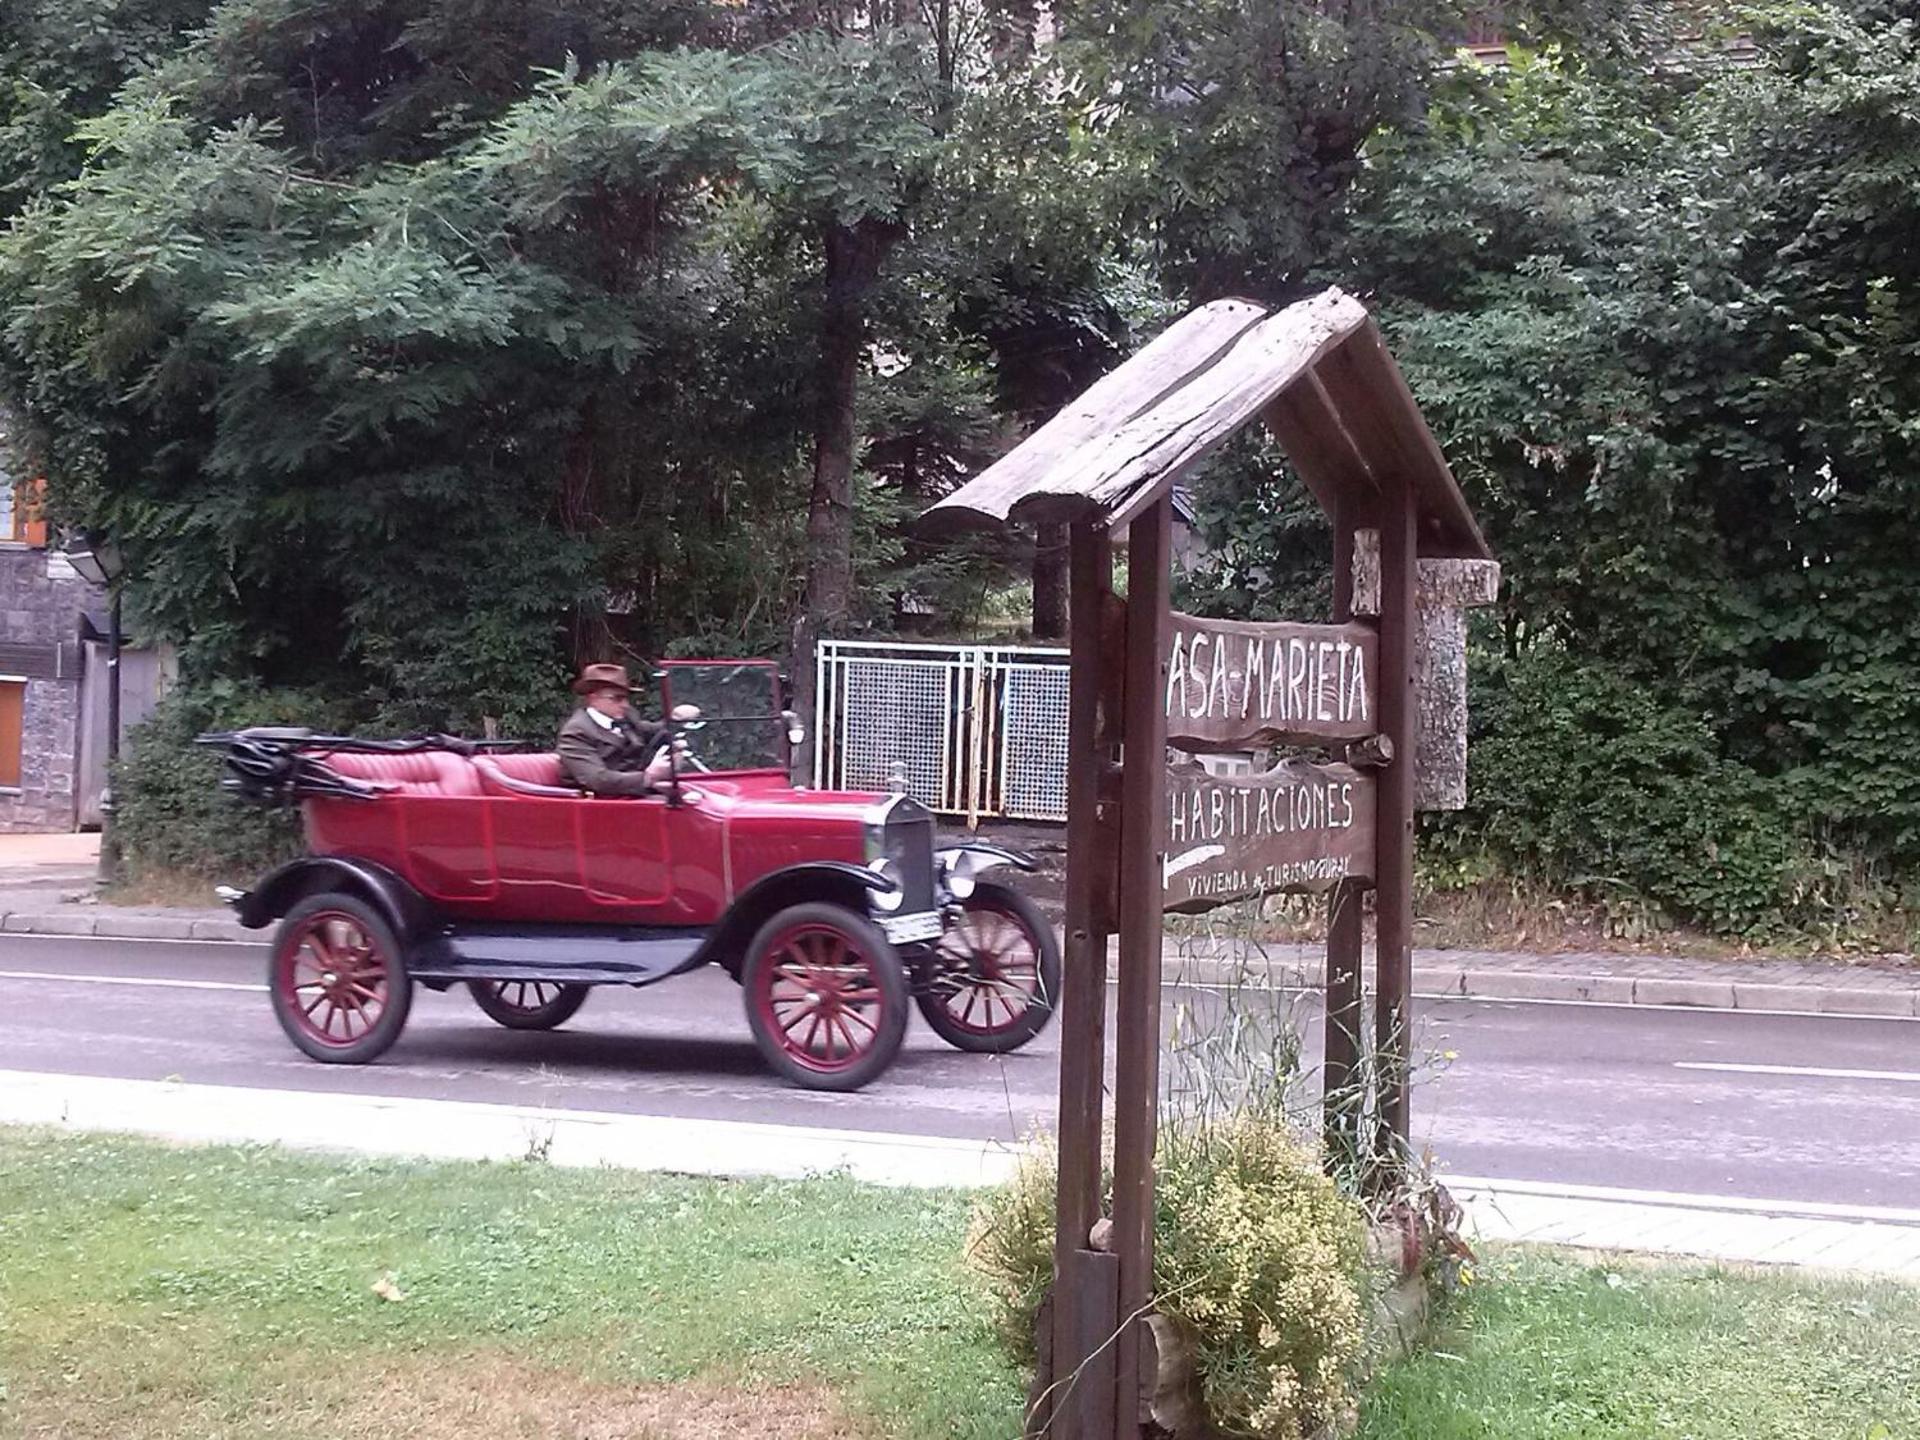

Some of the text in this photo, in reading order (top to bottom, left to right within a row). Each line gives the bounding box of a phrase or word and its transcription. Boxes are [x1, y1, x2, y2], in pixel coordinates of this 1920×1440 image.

[1165, 631, 1368, 722] ASA-MARIETA
[1170, 783, 1354, 842] HABITACIONES
[1187, 869, 1247, 897] VIVIENDA
